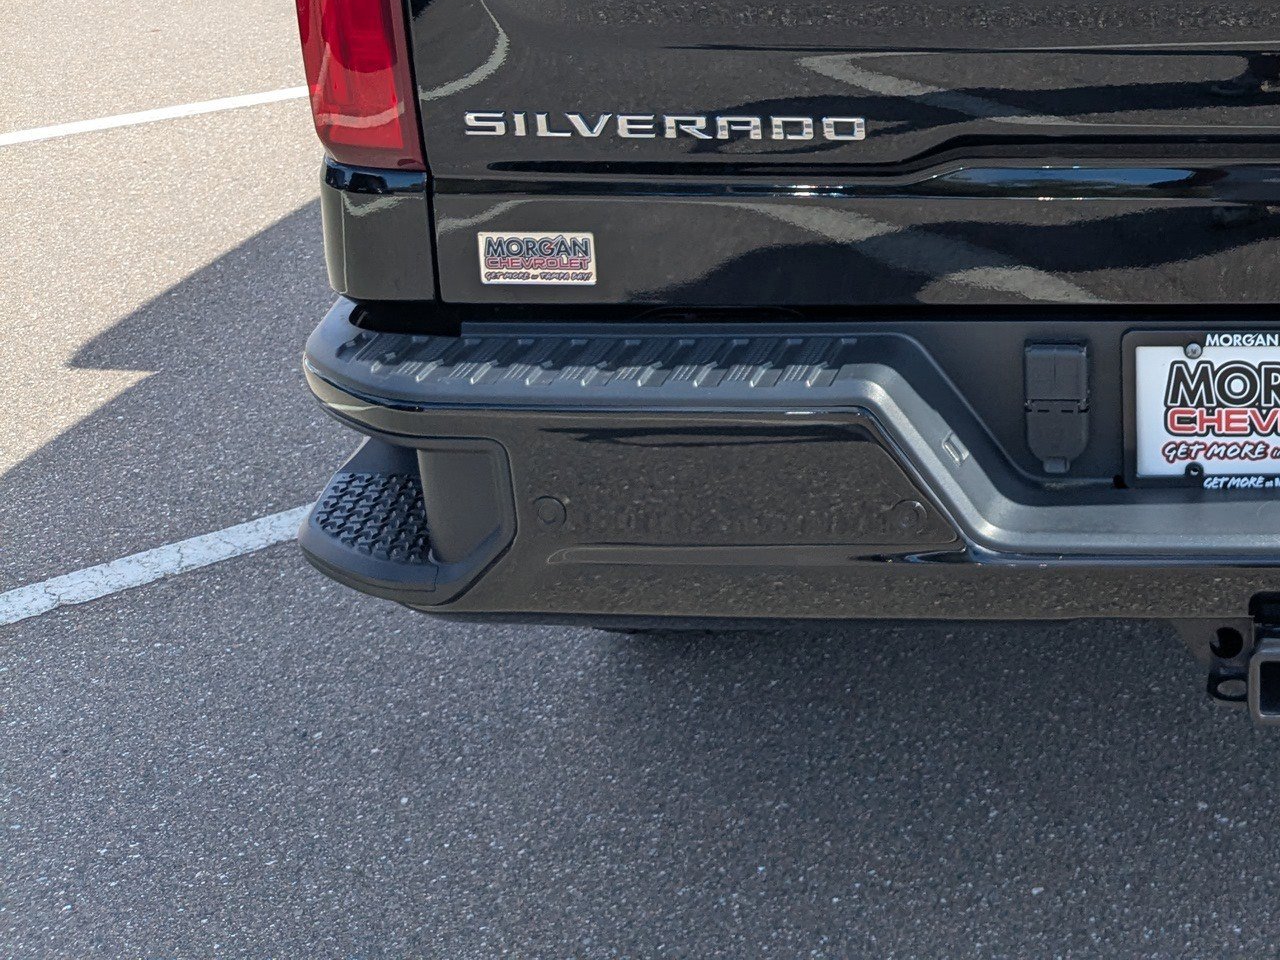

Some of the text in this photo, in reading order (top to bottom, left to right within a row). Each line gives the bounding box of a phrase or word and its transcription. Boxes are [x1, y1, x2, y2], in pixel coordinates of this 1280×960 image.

[463, 110, 867, 141] SILVERADO
[484, 234, 592, 258] MORGAN
[484, 256, 591, 270] CHEVROLET
[1205, 333, 1279, 347] MORGAN
[1162, 440, 1205, 463] GET
[1204, 440, 1269, 460] MORE
[1203, 476, 1229, 489] GET
[1226, 476, 1265, 488] MORE
